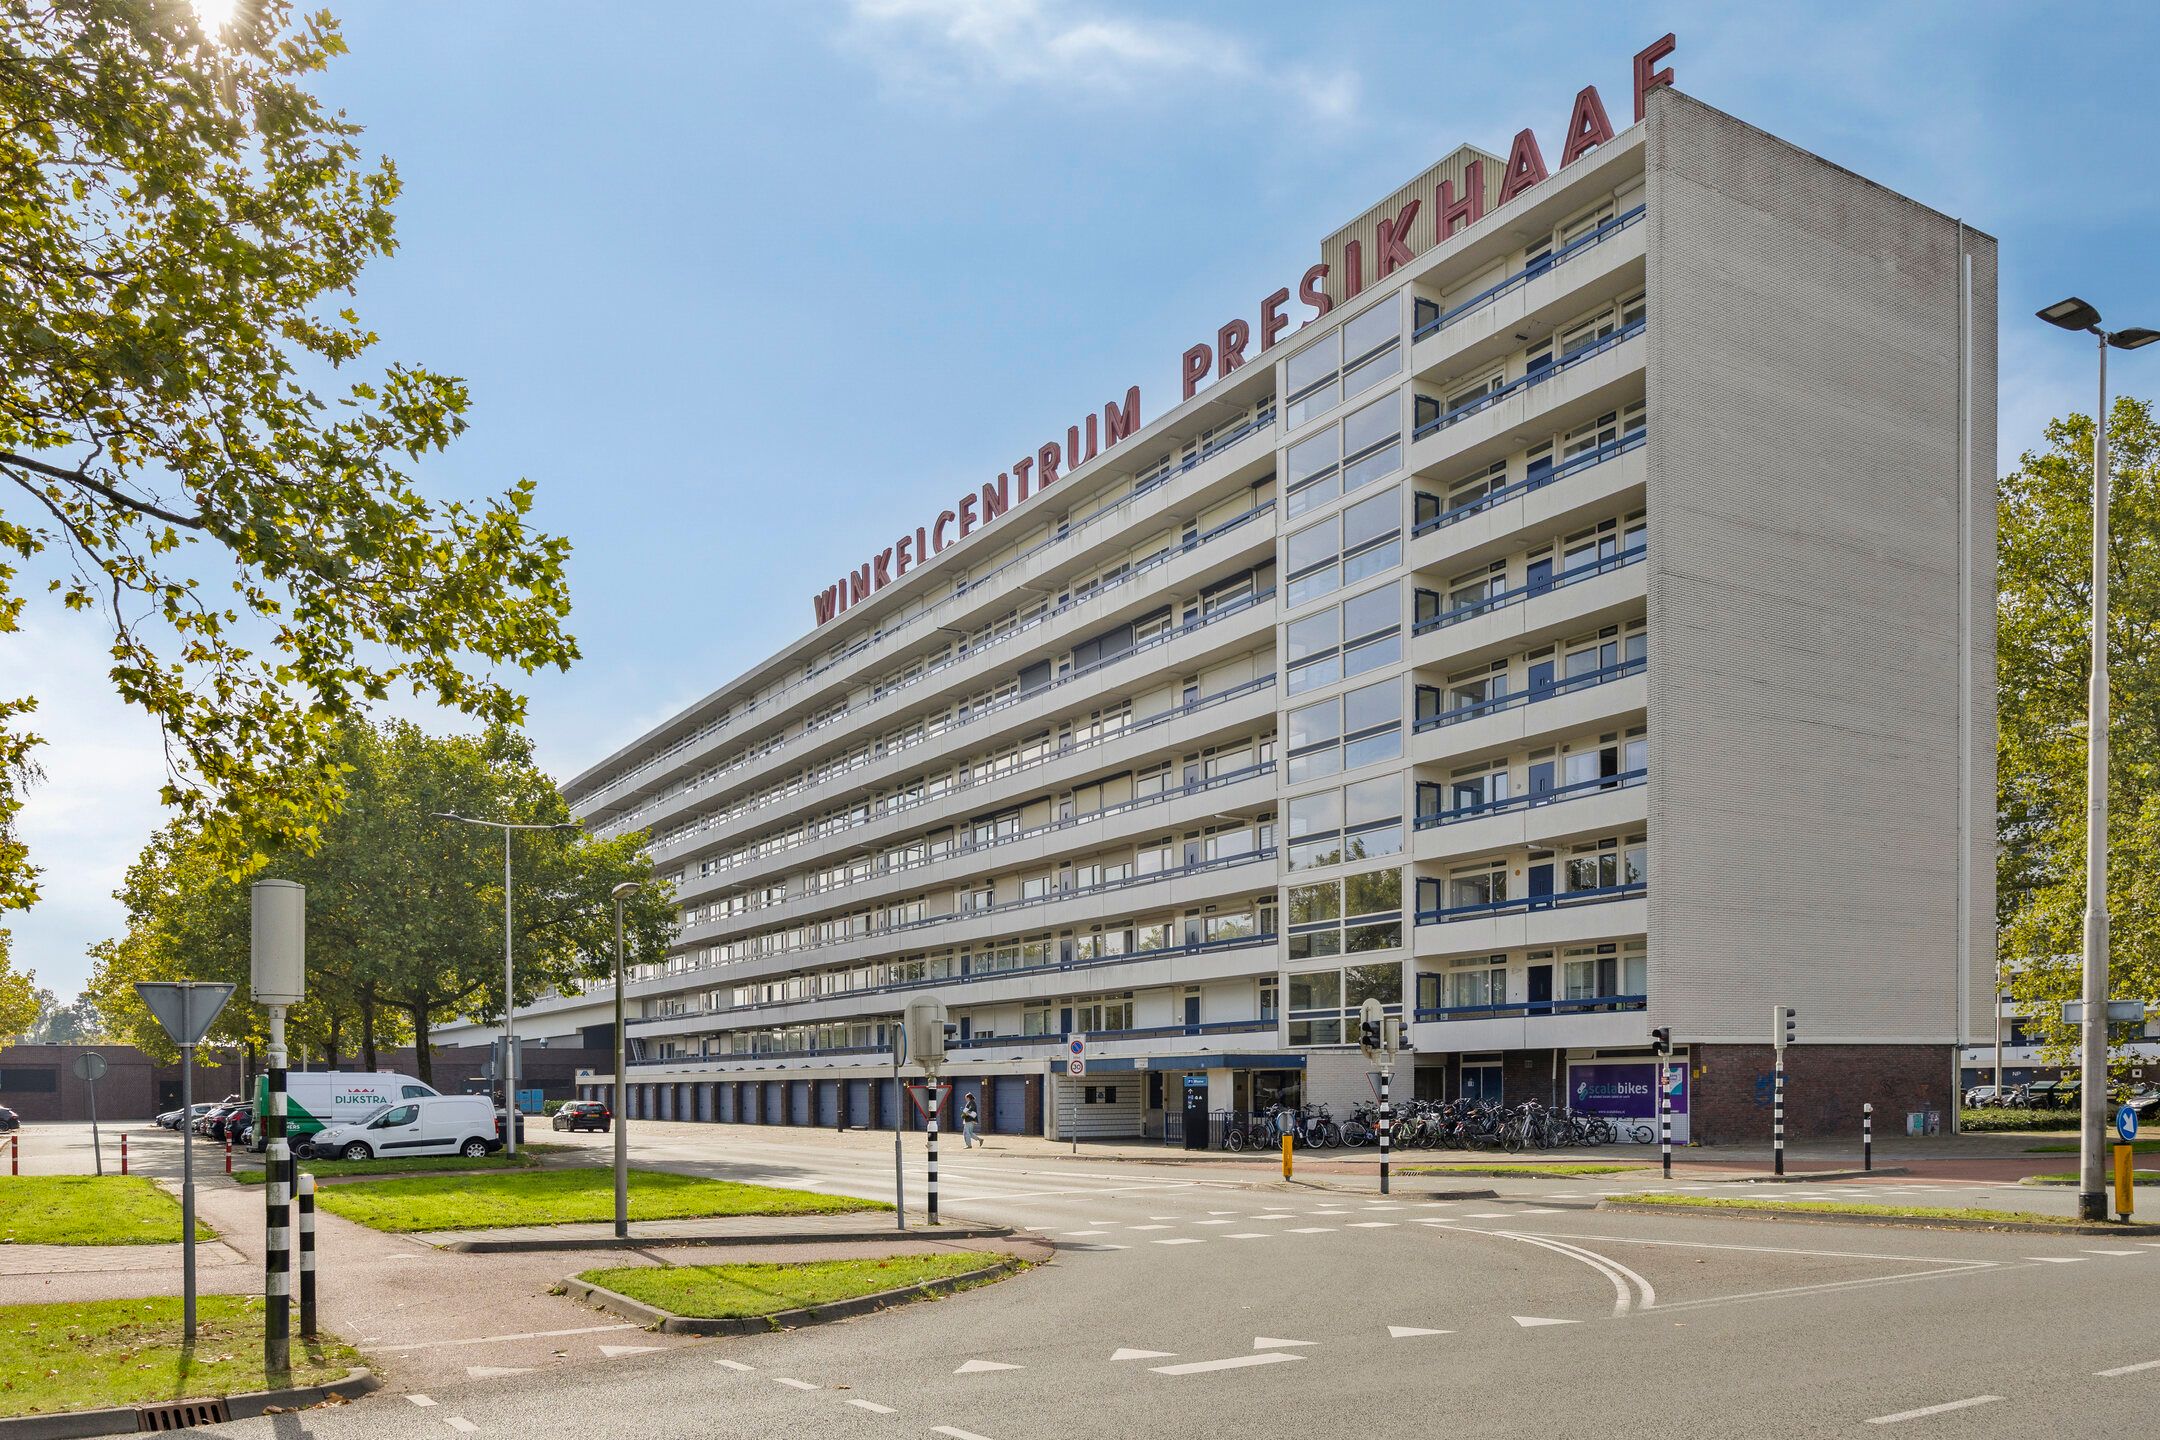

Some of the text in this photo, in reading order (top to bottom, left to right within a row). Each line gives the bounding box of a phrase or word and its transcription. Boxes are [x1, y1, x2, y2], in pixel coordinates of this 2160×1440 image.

[813, 32, 1675, 627] WINKELCENTRUM PRESIKHAAF
[1589, 1082, 1648, 1094] scalabikes
[335, 1095, 387, 1104] DIJKSTRA
